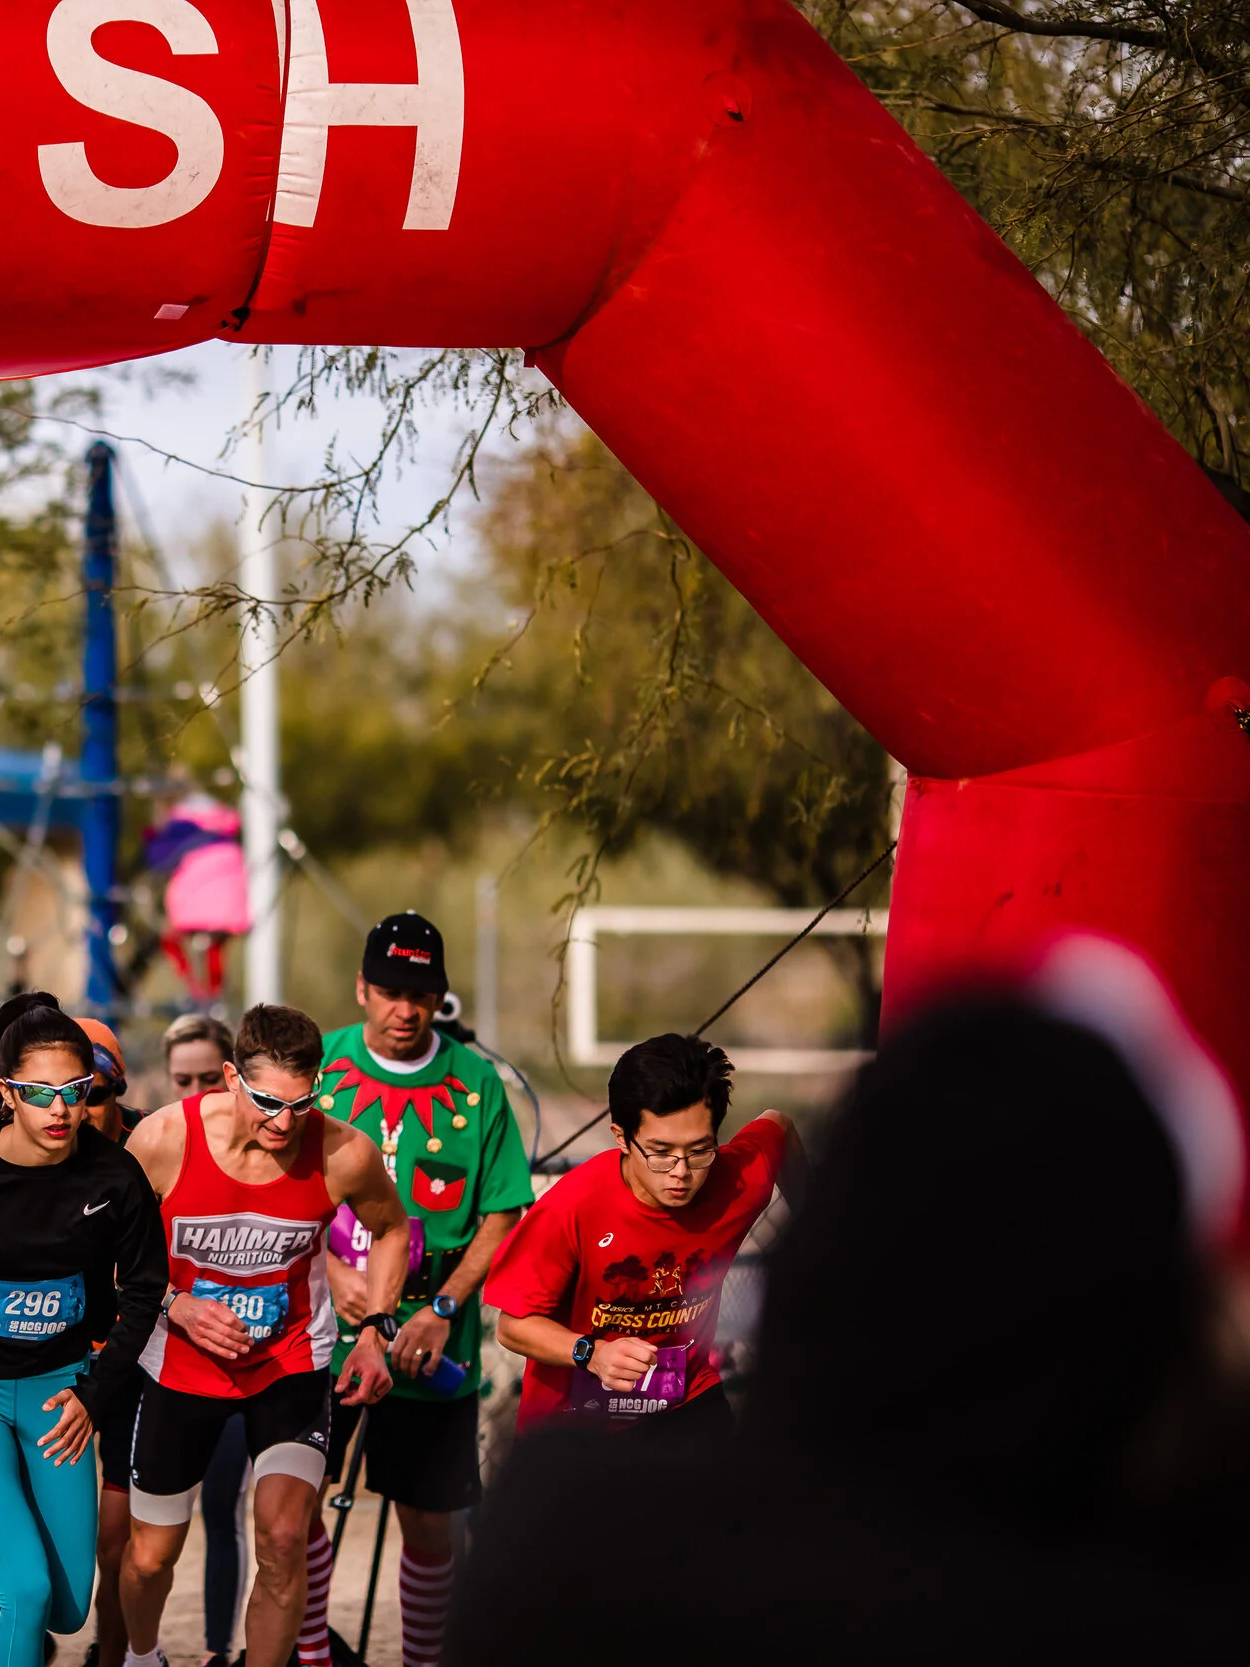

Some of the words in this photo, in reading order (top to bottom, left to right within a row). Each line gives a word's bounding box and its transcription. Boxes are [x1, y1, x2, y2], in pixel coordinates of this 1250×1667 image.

[181, 1226, 313, 1253] HAMMER
[207, 1251, 283, 1266] NUTRITION
[4, 1290, 62, 1317] 296
[591, 1307, 646, 1329] CROSS
